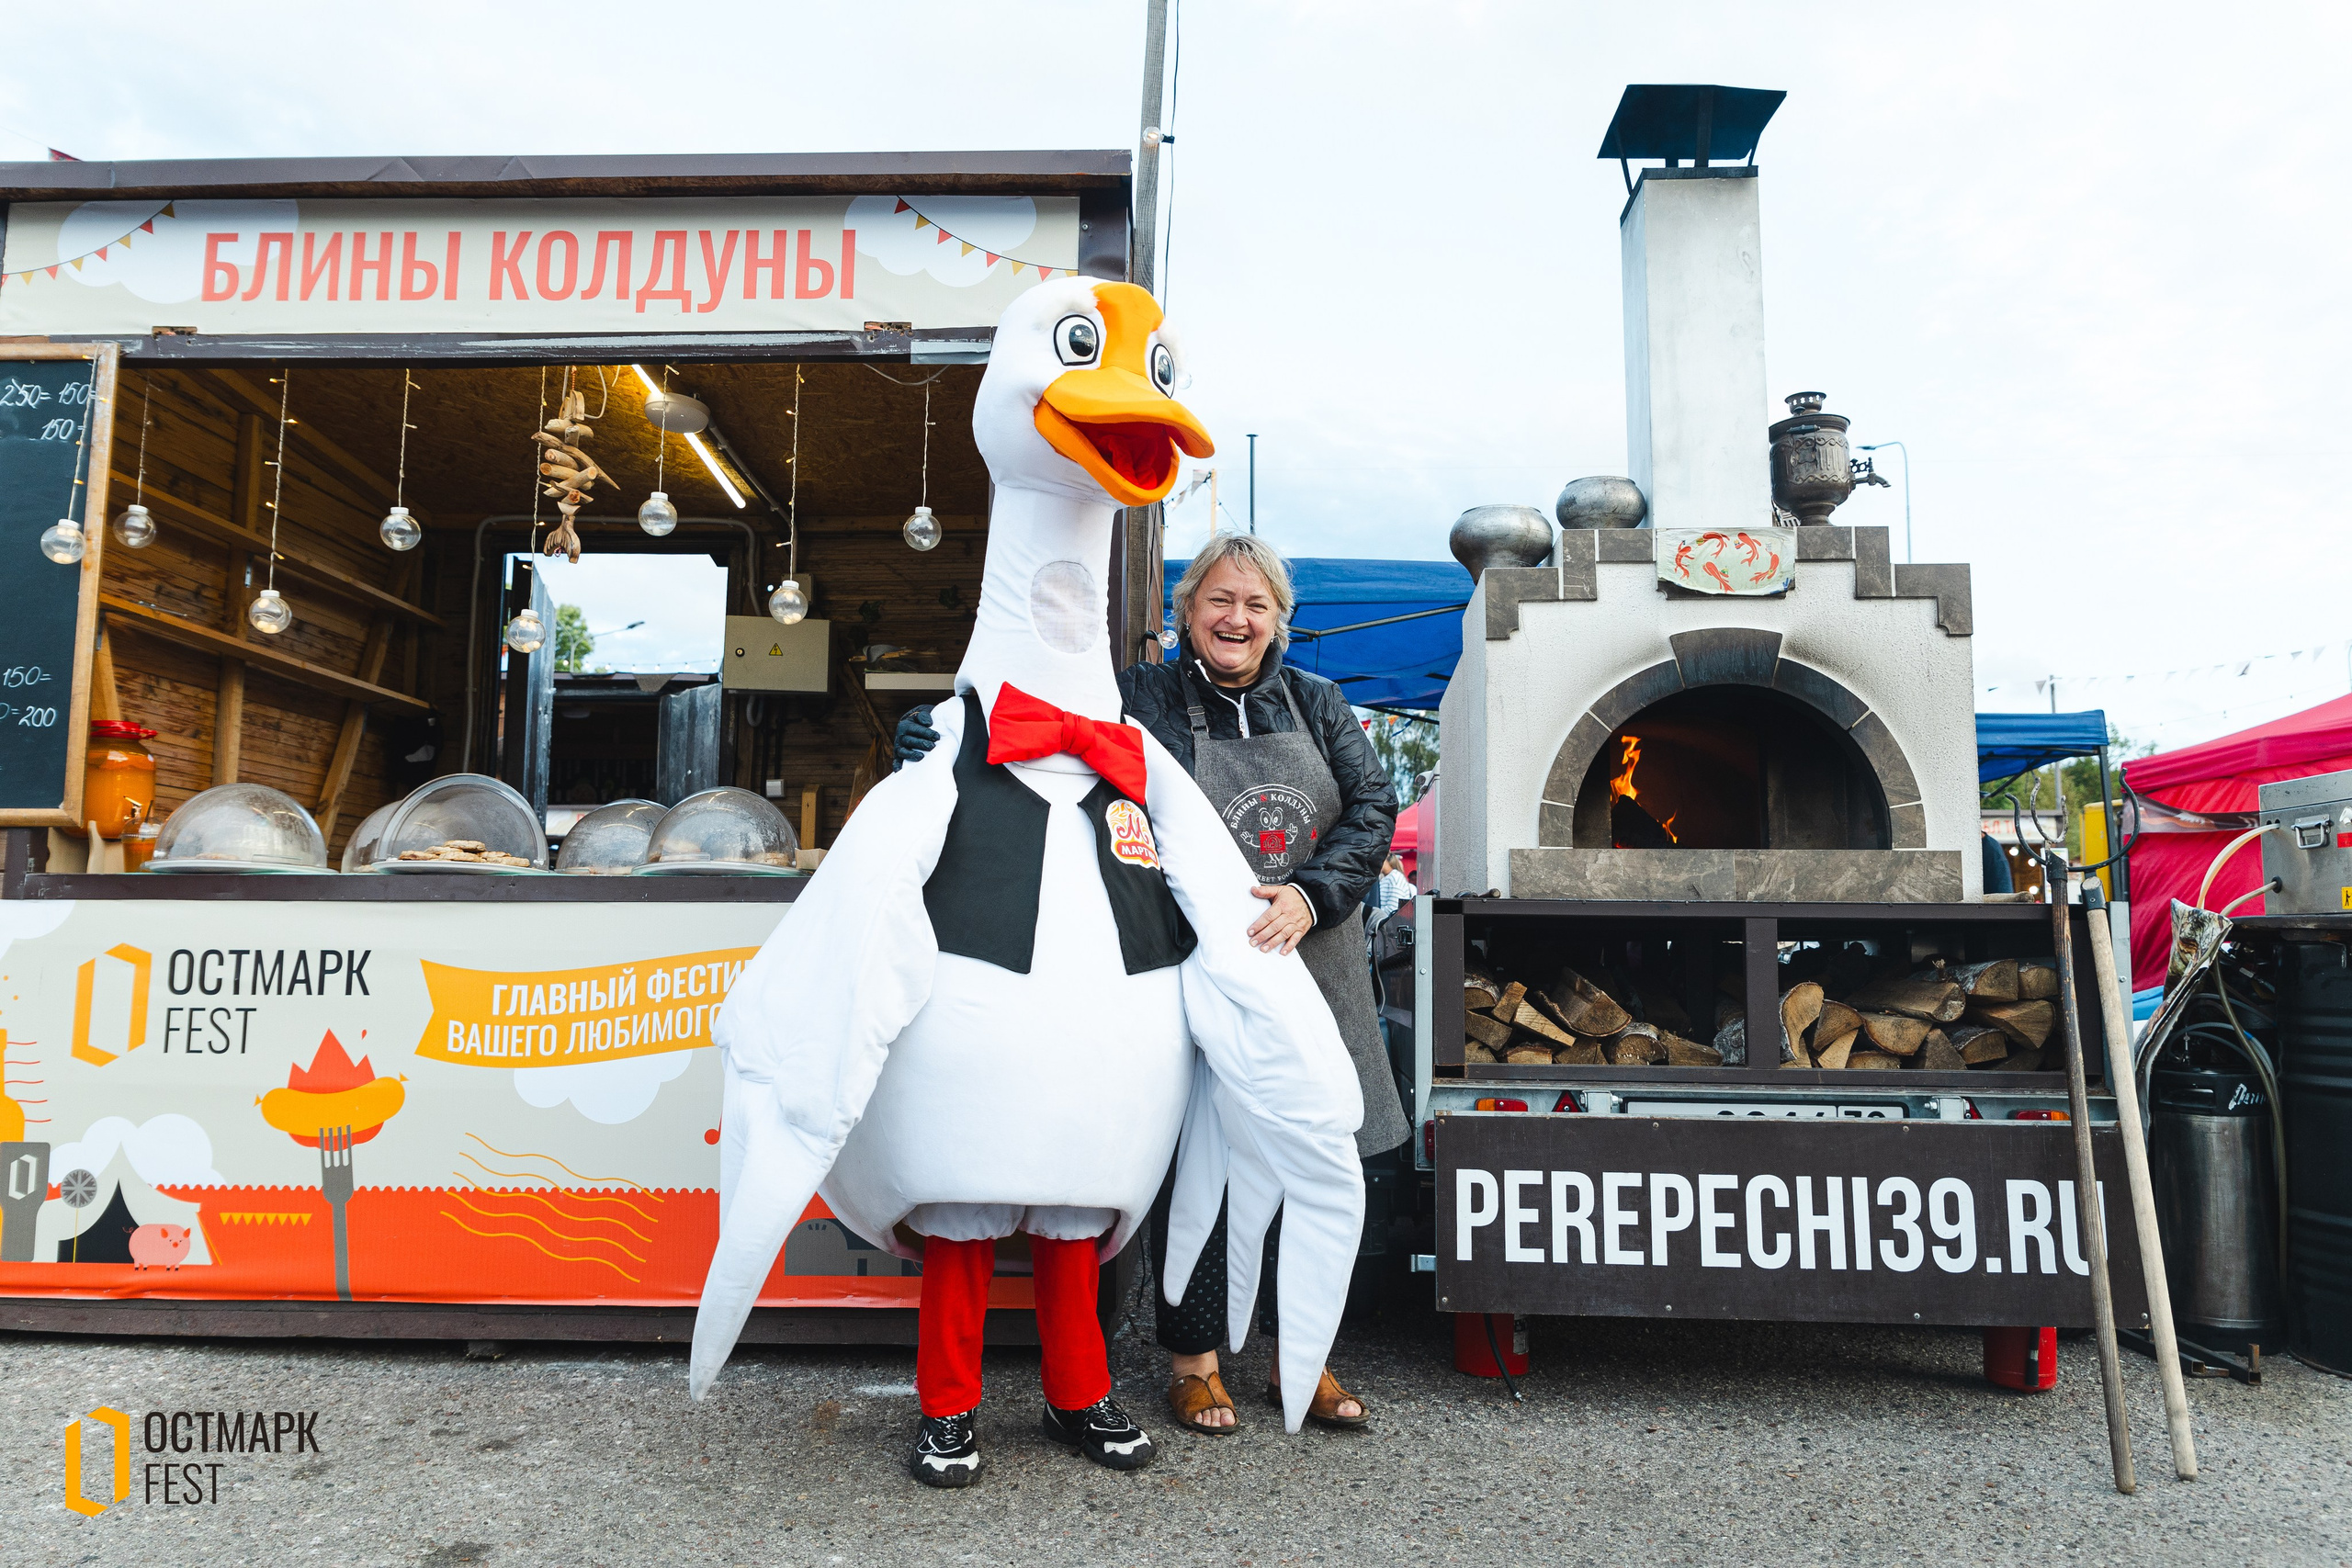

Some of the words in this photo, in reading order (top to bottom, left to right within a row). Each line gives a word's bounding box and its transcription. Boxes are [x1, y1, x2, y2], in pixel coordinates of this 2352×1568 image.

[201, 231, 462, 302] БЛИНЫ
[488, 229, 856, 313] КОЛДУНЫ
[1231, 797, 1258, 829] БЛИНЫ
[1271, 793, 1311, 824] КОЛДУНЫ
[1277, 868, 1294, 882] FOOD
[168, 949, 372, 996] ОСТМАРК
[492, 967, 638, 1016] ГЛАВНЫЙ
[647, 961, 752, 1003] ФЕСТИ
[164, 1007, 257, 1054] FEST
[447, 1020, 558, 1057] ВАШЕГО
[1455, 1168, 2109, 1276] PEREPECHI39.RU
